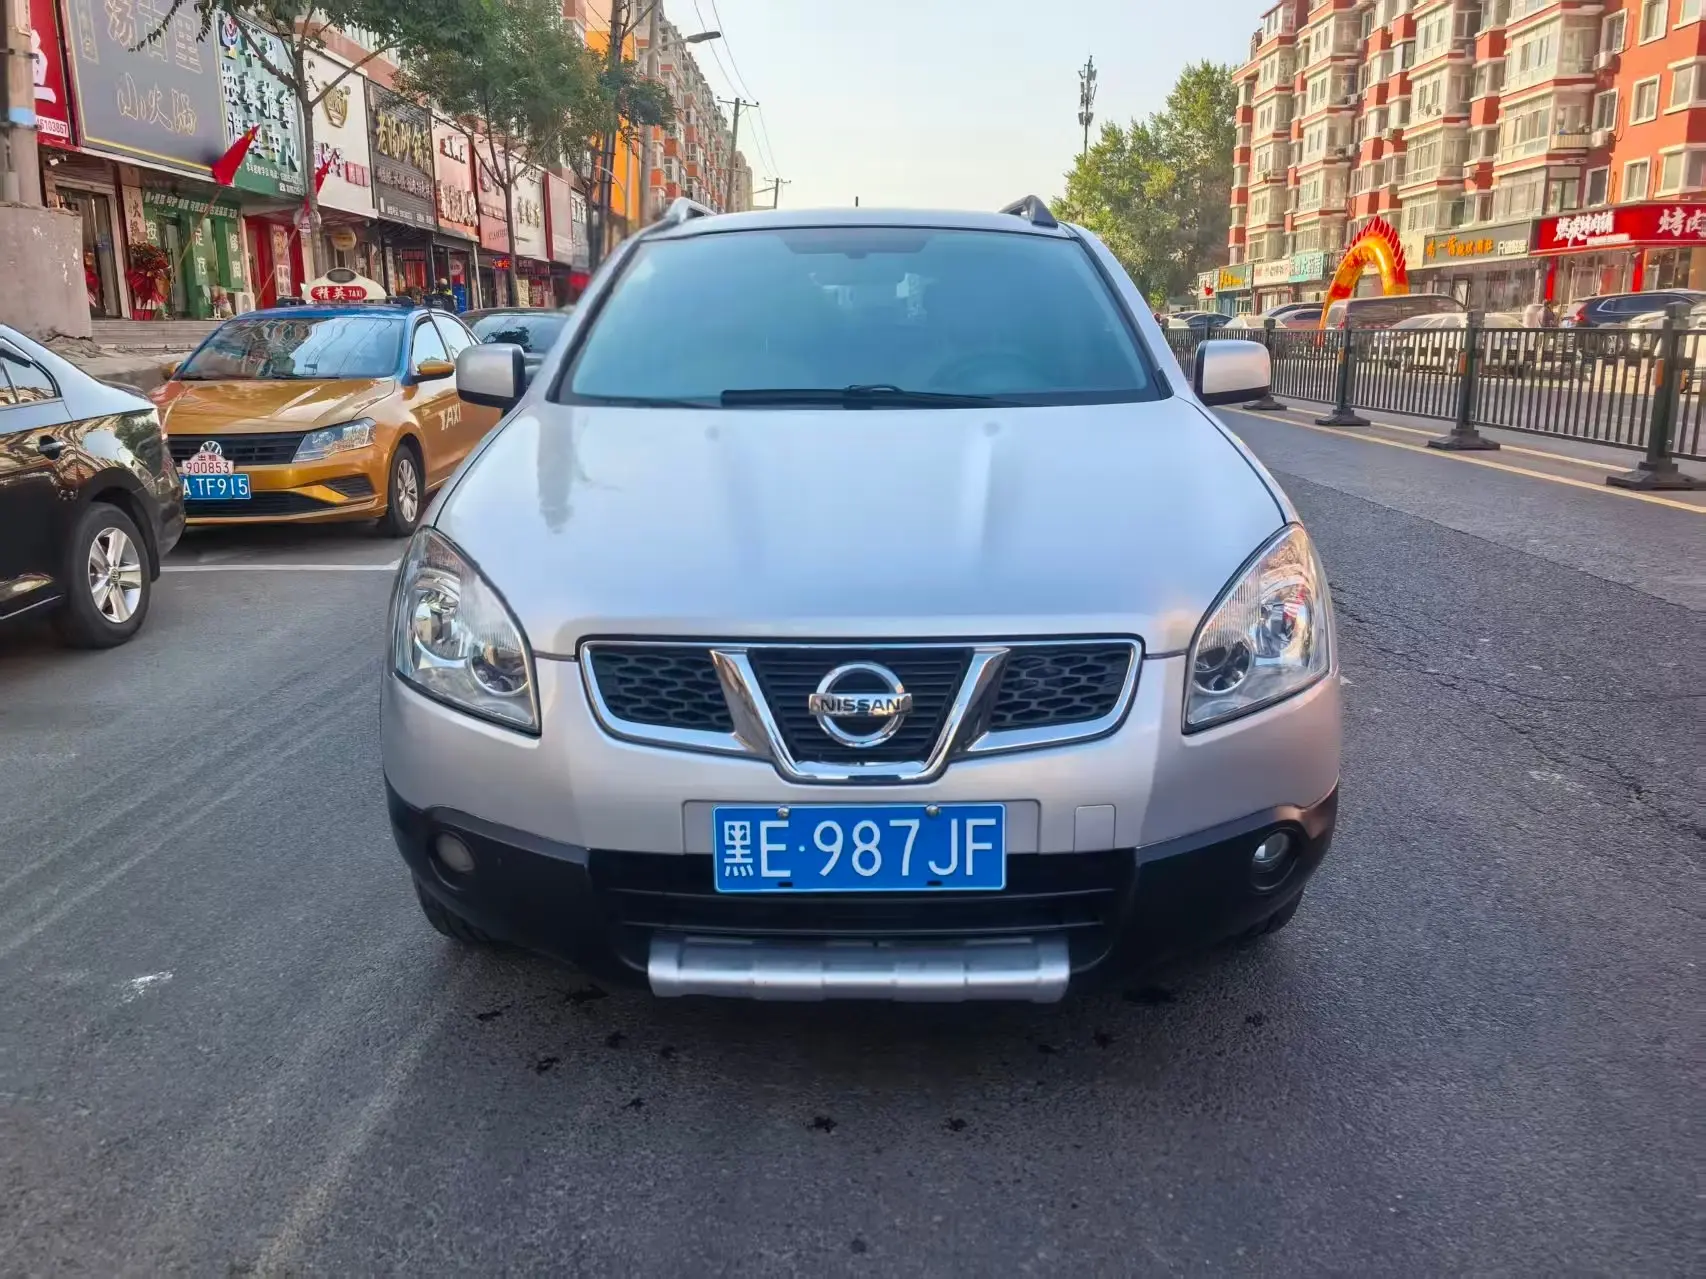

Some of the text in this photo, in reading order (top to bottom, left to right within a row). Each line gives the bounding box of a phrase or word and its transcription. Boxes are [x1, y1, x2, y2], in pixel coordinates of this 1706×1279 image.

[316, 286, 364, 300] 精英 TAXI
[439, 402, 462, 431] TAXI
[186, 461, 230, 474] 900853
[819, 697, 903, 713] NISSAN
[723, 818, 997, 878] 黑E·987JF
